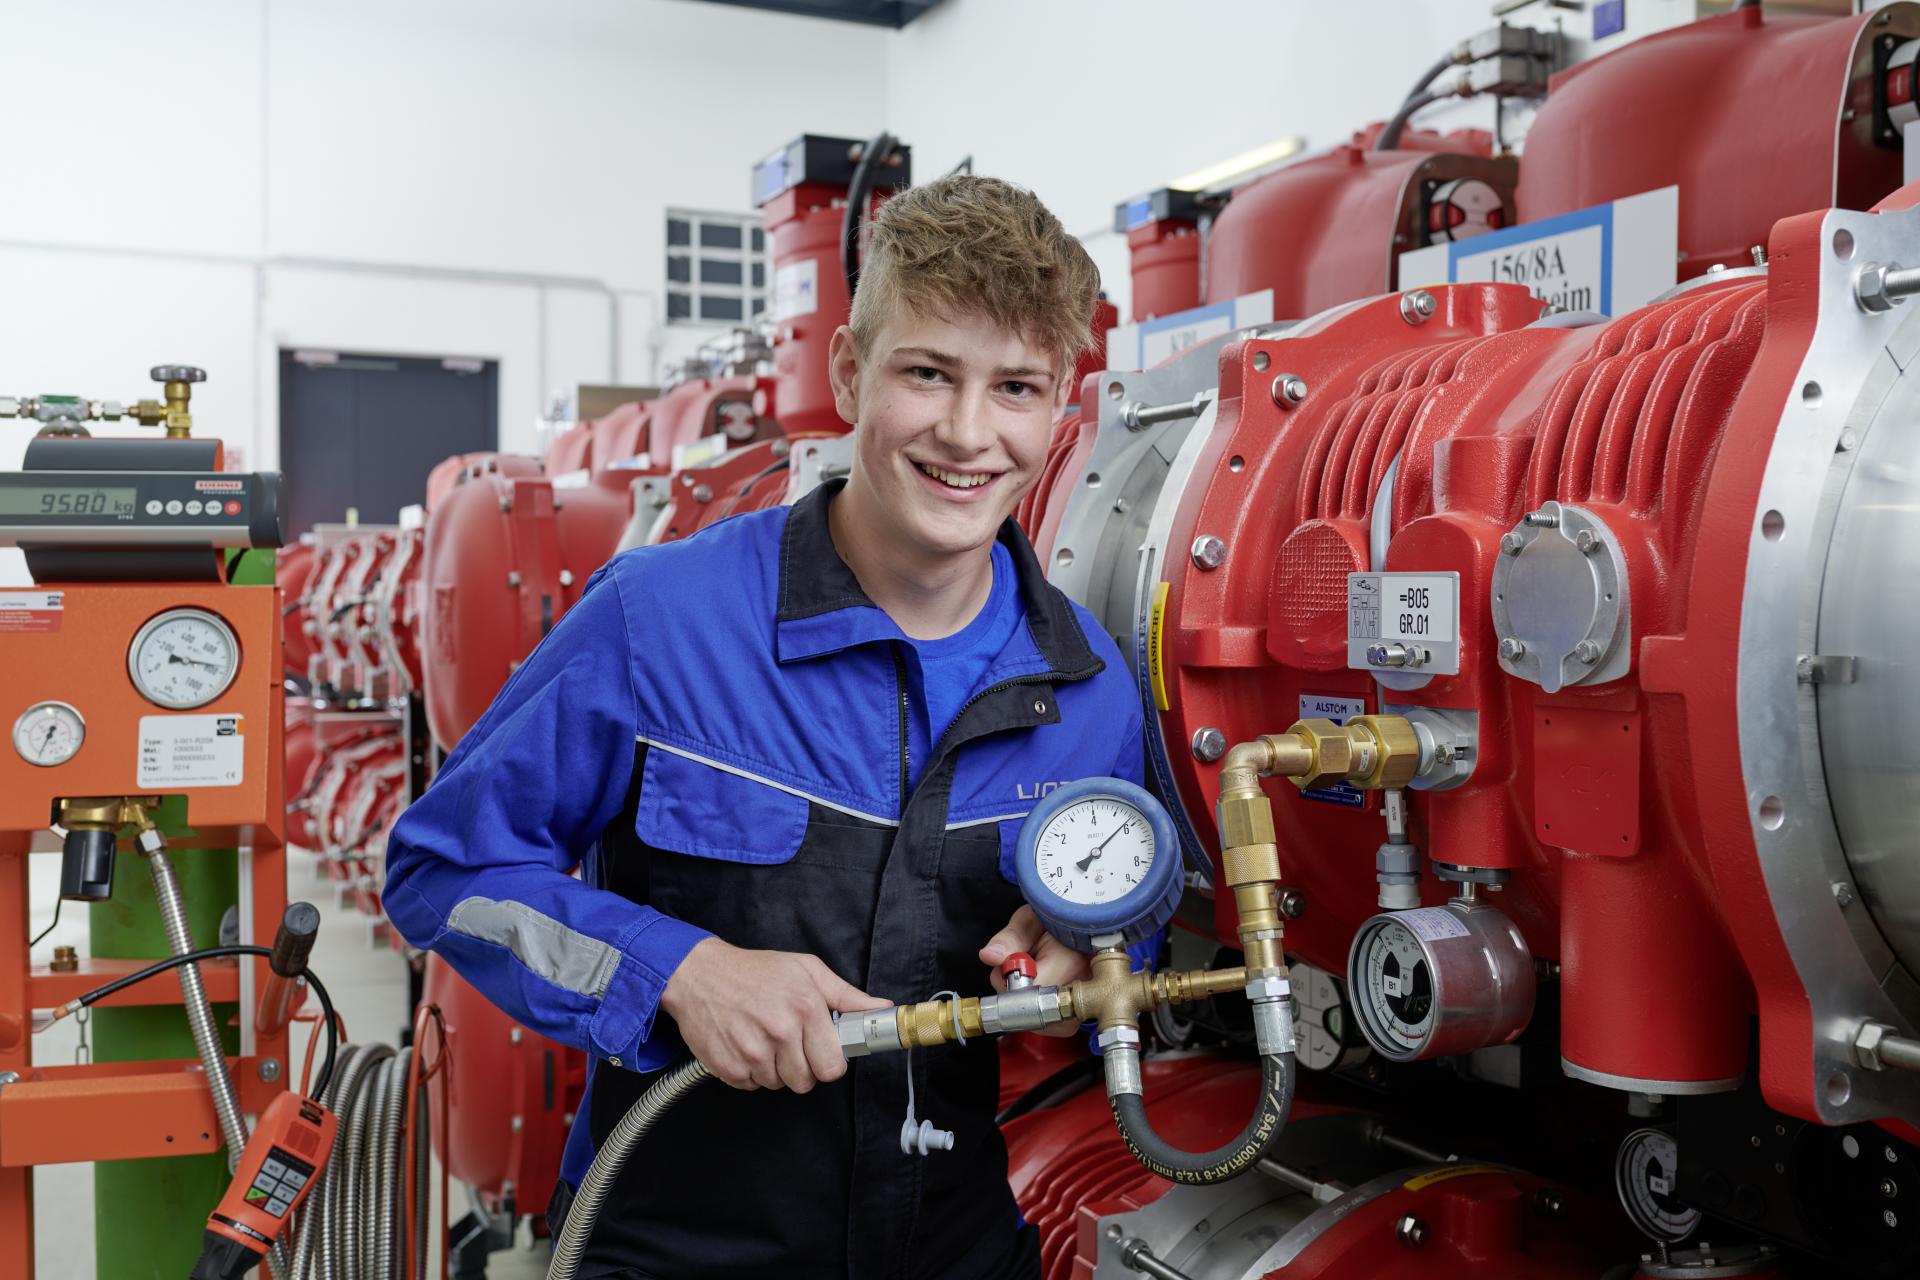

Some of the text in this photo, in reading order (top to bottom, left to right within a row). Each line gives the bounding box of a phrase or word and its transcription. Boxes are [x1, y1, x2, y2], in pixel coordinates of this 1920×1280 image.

[1492, 245, 1564, 283] 156/8A
[113, 499, 134, 515] kg
[1399, 587, 1429, 609] =B05
[1399, 613, 1429, 635] GR.01
[1151, 608, 1160, 676] GASDICHT
[1316, 702, 1347, 714] ALSTOM
[1090, 815, 1097, 827] 4
[1123, 823, 1130, 835] 6
[1061, 833, 1067, 845] 2
[1133, 855, 1140, 867] 8
[1056, 866, 1063, 878] 0
[1125, 873, 1131, 882] 9
[1256, 1113, 1276, 1141] SAE
[1203, 1140, 1261, 1180] 100R1AT-8
[1152, 1163, 1173, 1177] mm
[1176, 1170, 1201, 1183] 12,5
